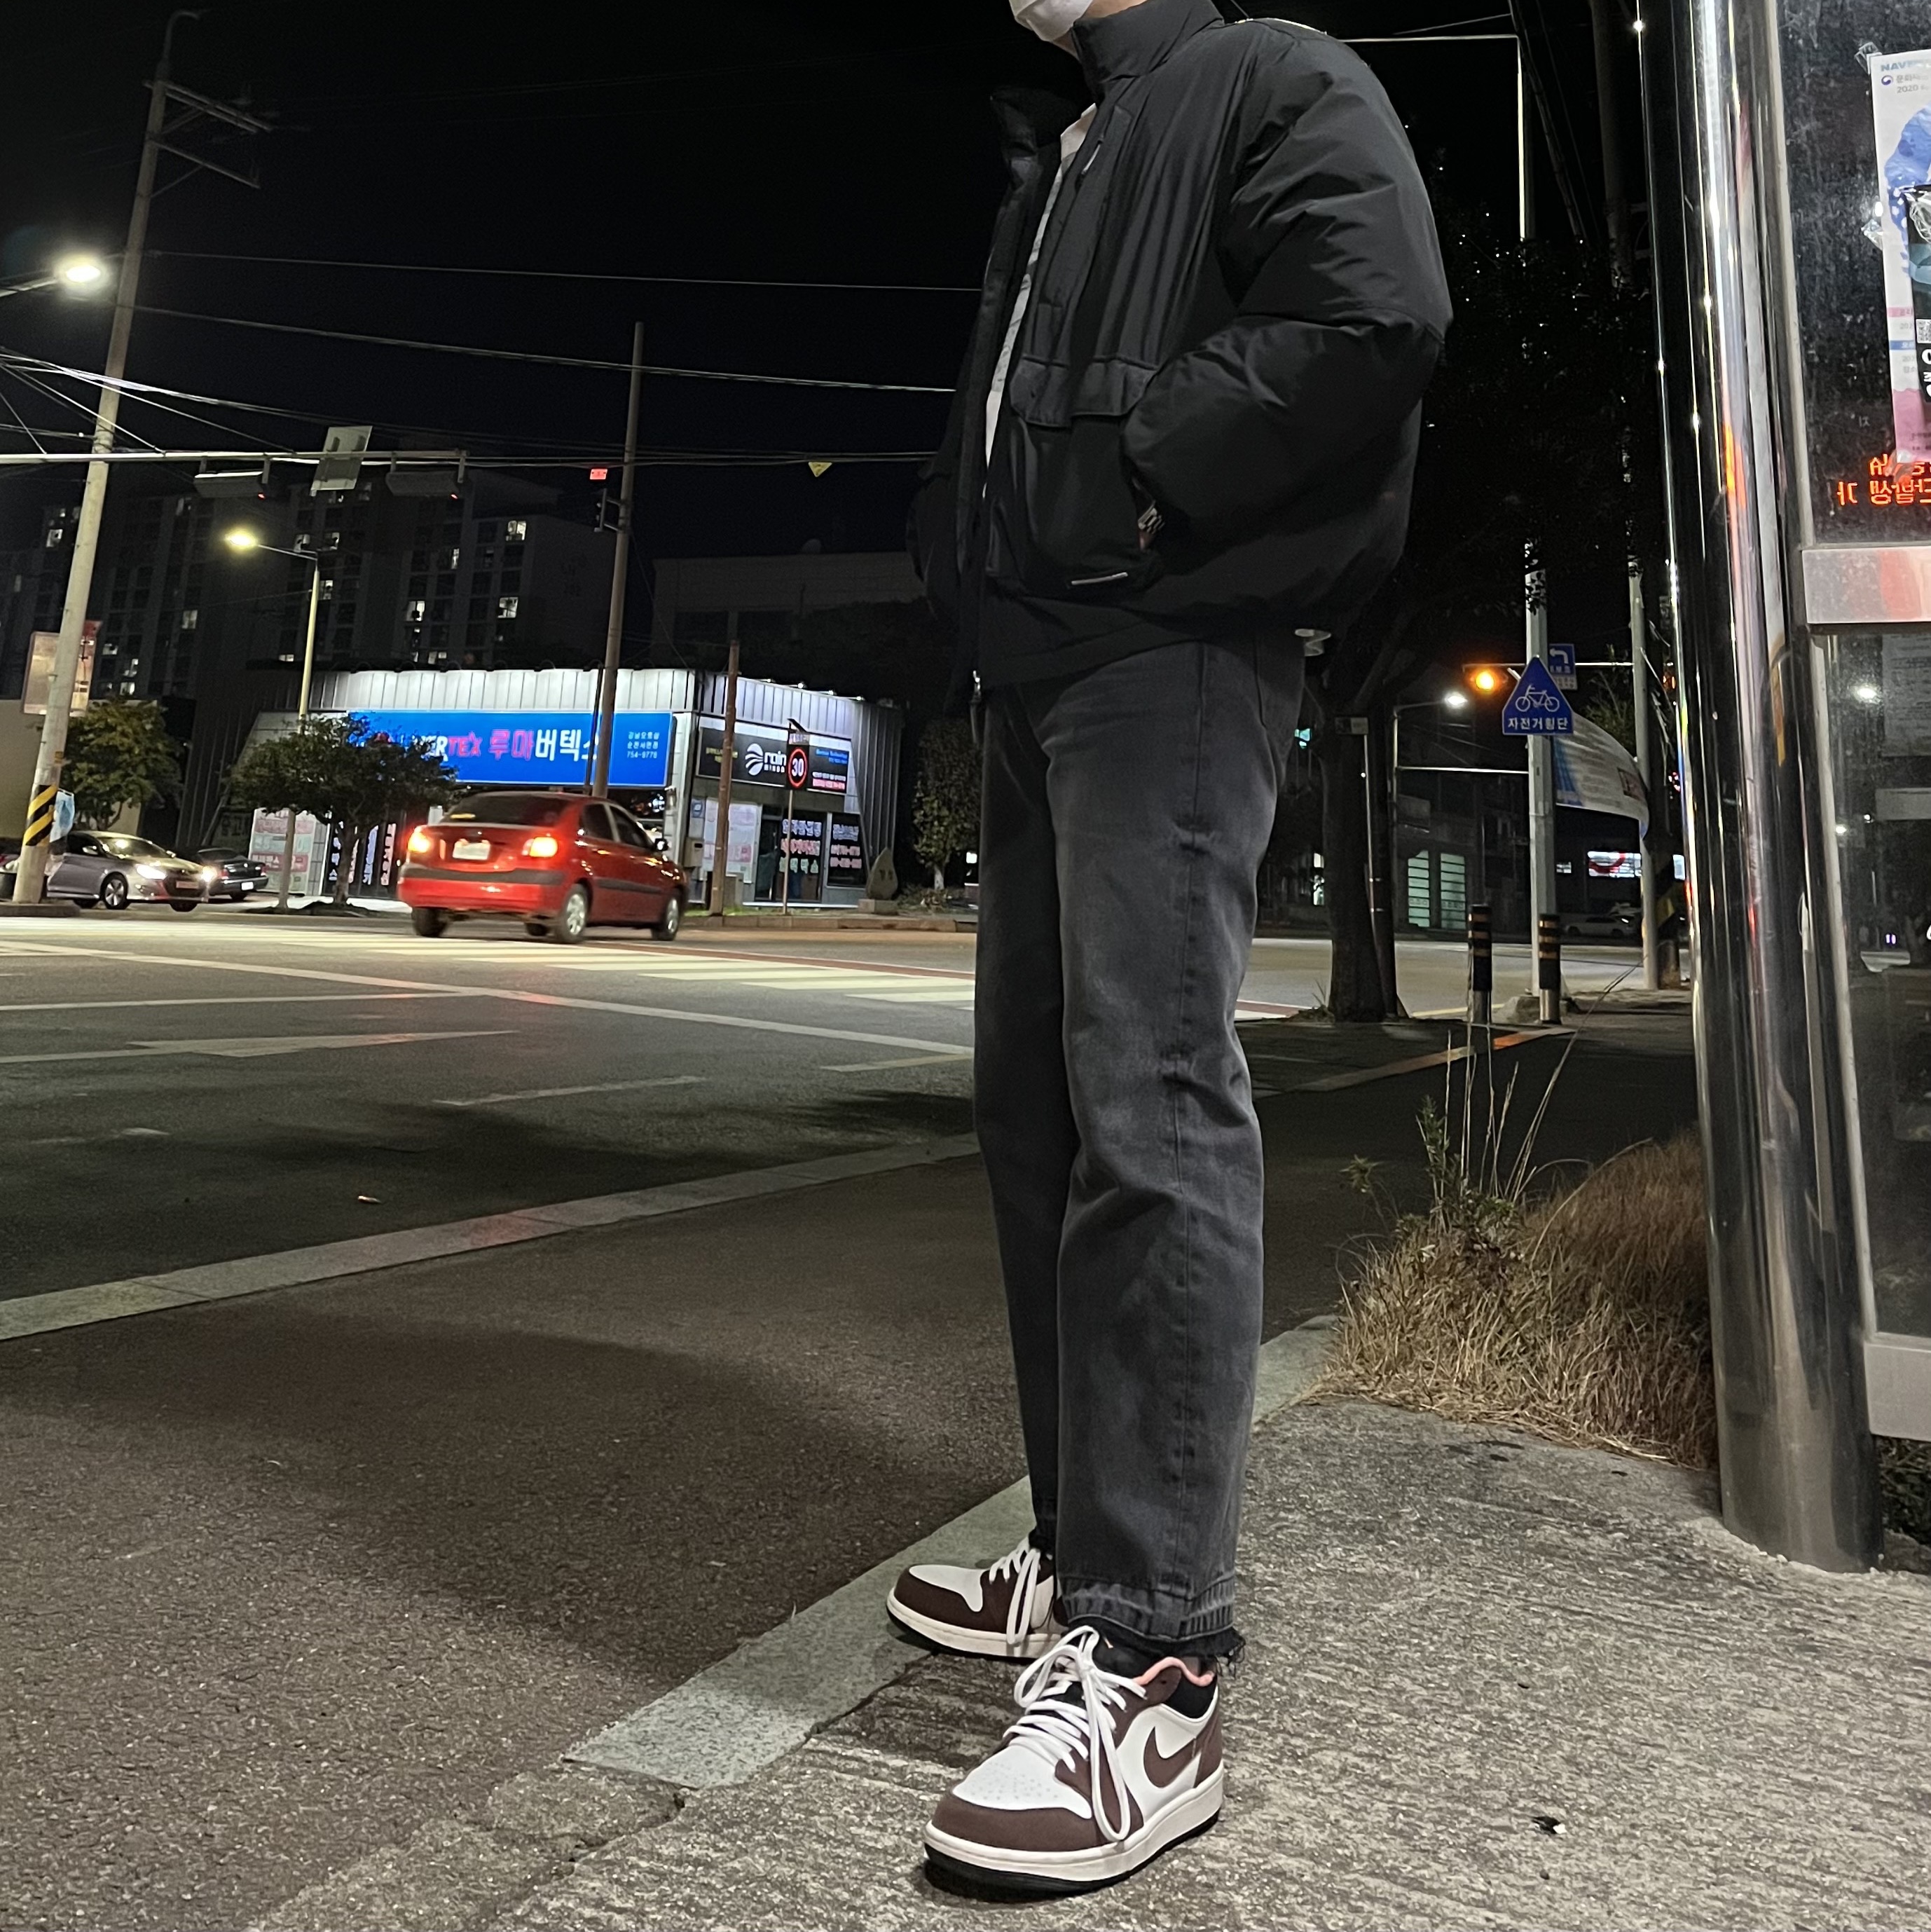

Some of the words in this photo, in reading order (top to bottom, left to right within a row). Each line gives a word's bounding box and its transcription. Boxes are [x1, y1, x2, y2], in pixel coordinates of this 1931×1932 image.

[1897, 85, 1919, 93] 2020
[1507, 717, 1569, 731] 자전거횡단
[791, 758, 804, 777] 30
